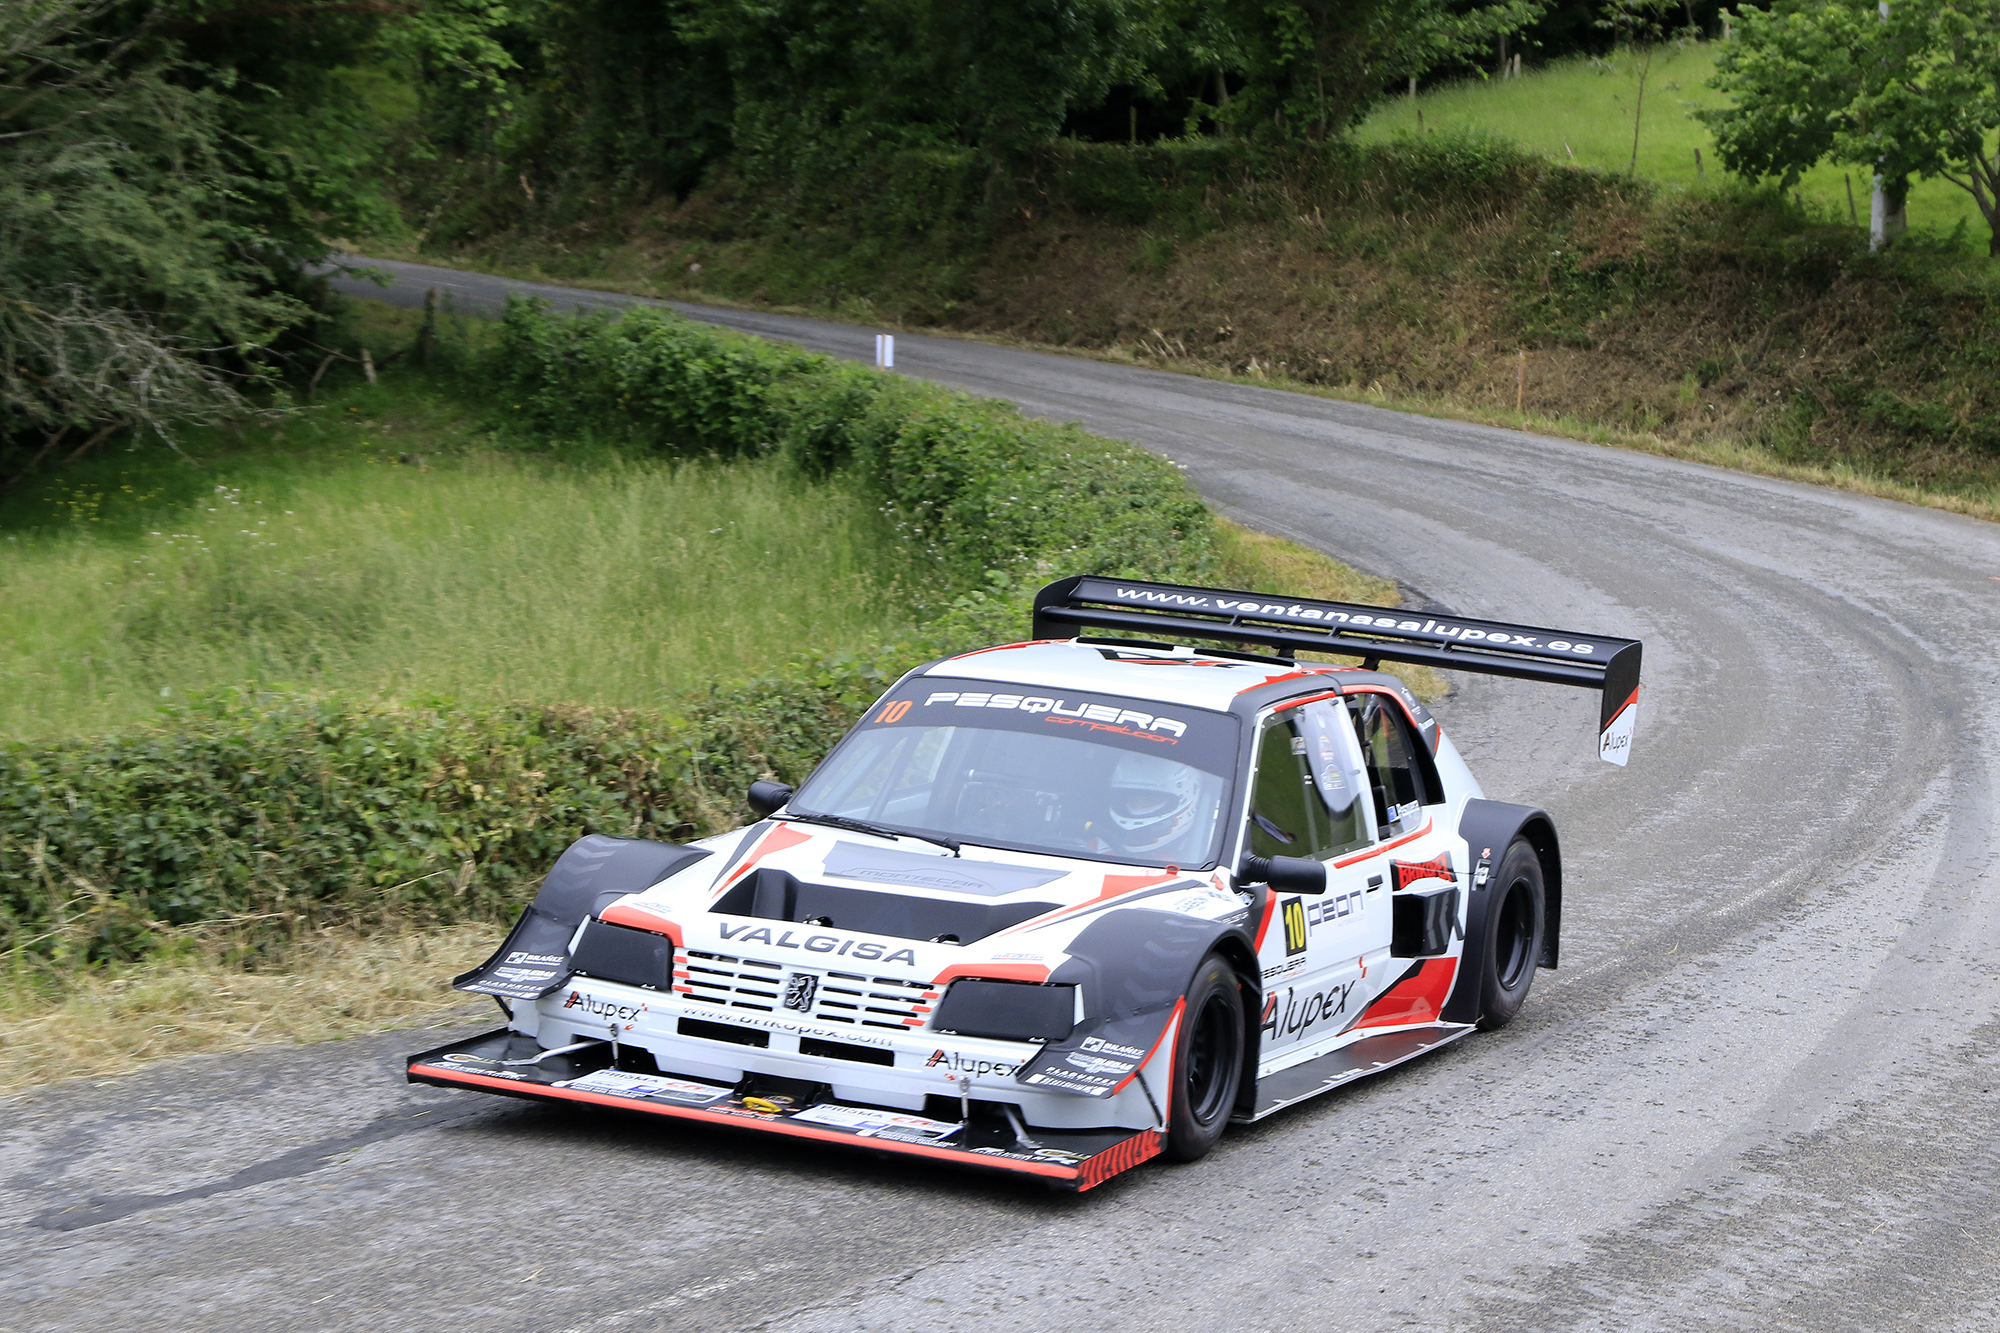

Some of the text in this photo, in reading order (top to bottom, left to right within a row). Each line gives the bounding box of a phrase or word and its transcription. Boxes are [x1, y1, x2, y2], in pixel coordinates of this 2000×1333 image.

[1116, 585, 1595, 655] www.ventanasalupex.es
[873, 699, 913, 724] 10
[923, 691, 1188, 738] PESQUERA
[719, 922, 916, 966] VALGISA
[1284, 901, 1306, 951] 10
[563, 991, 642, 1022] Alupex
[1261, 979, 1356, 1041] Alupex
[924, 1049, 1020, 1079] Alupex
